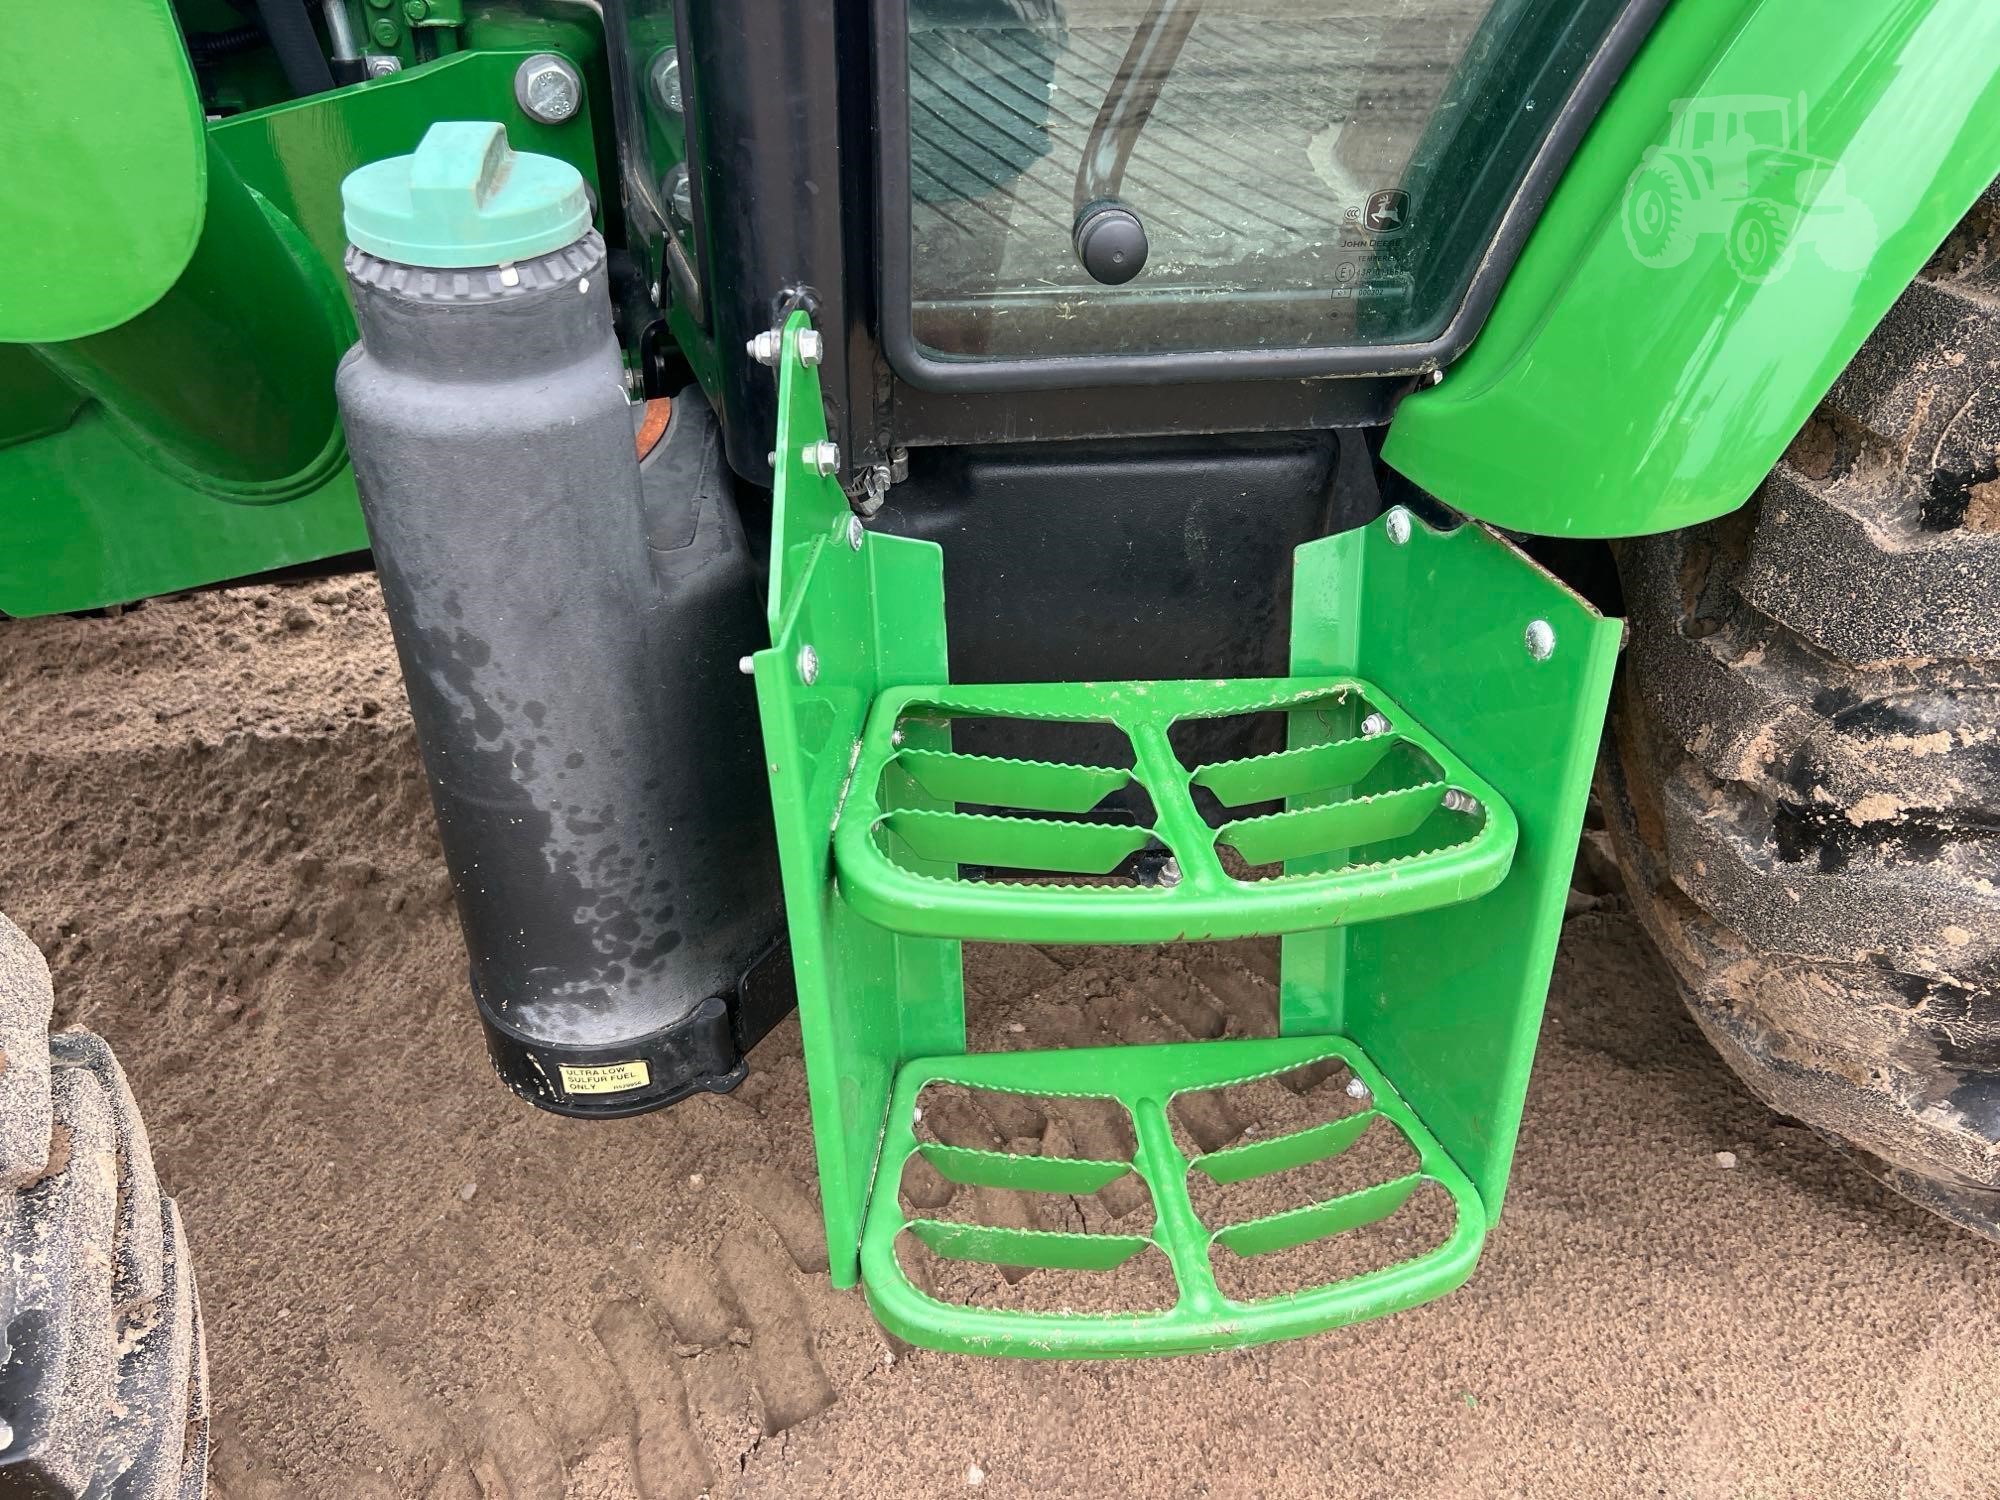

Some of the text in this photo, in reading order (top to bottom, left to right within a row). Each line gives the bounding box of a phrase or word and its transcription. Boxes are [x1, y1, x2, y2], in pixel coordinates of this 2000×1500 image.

[1341, 239, 1401, 248] JOHN DEERE
[602, 1066, 625, 1075] LOW
[610, 1072, 636, 1081] FUEL
